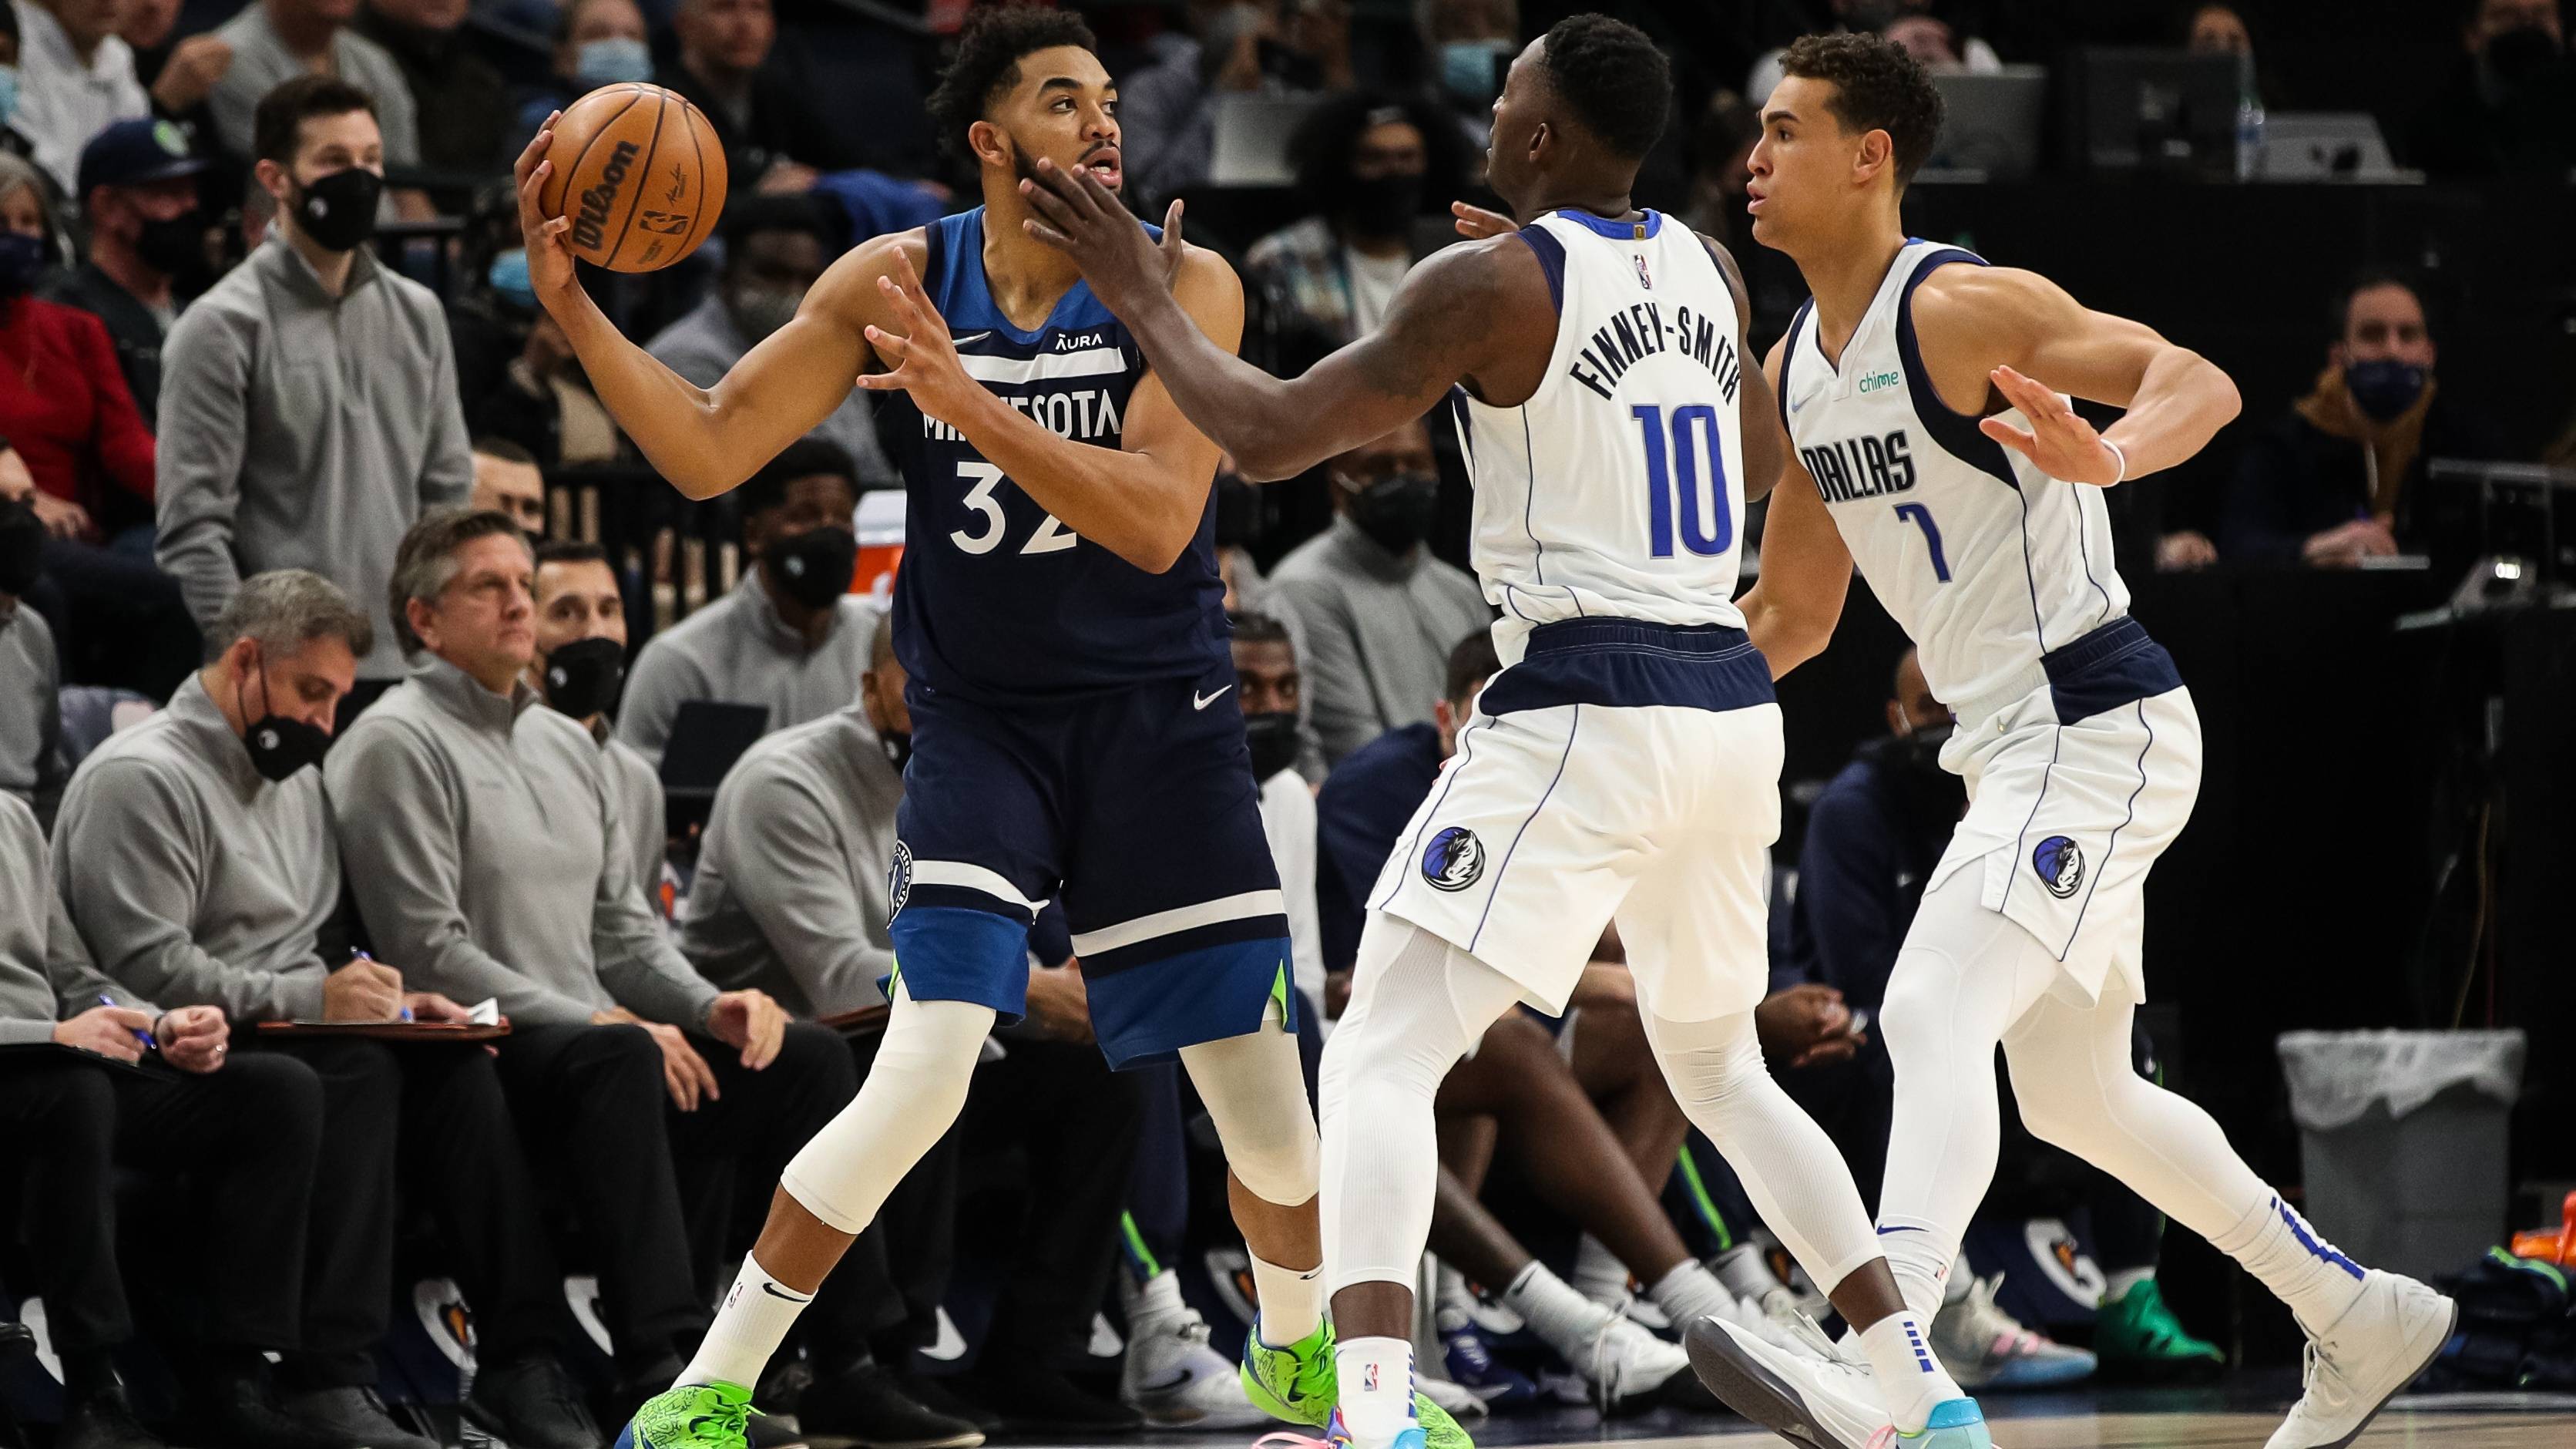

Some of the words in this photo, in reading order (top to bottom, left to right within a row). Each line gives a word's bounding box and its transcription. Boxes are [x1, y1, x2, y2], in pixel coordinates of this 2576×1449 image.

[573, 141, 640, 251] Wilson
[1569, 302, 1741, 407] FINNEY-SMITH
[1859, 370, 1899, 393] chime
[923, 388, 1122, 442] MSOTA
[1630, 403, 1733, 560] 10
[1799, 429, 1918, 504] DALLAS
[1892, 501, 1953, 584] 7
